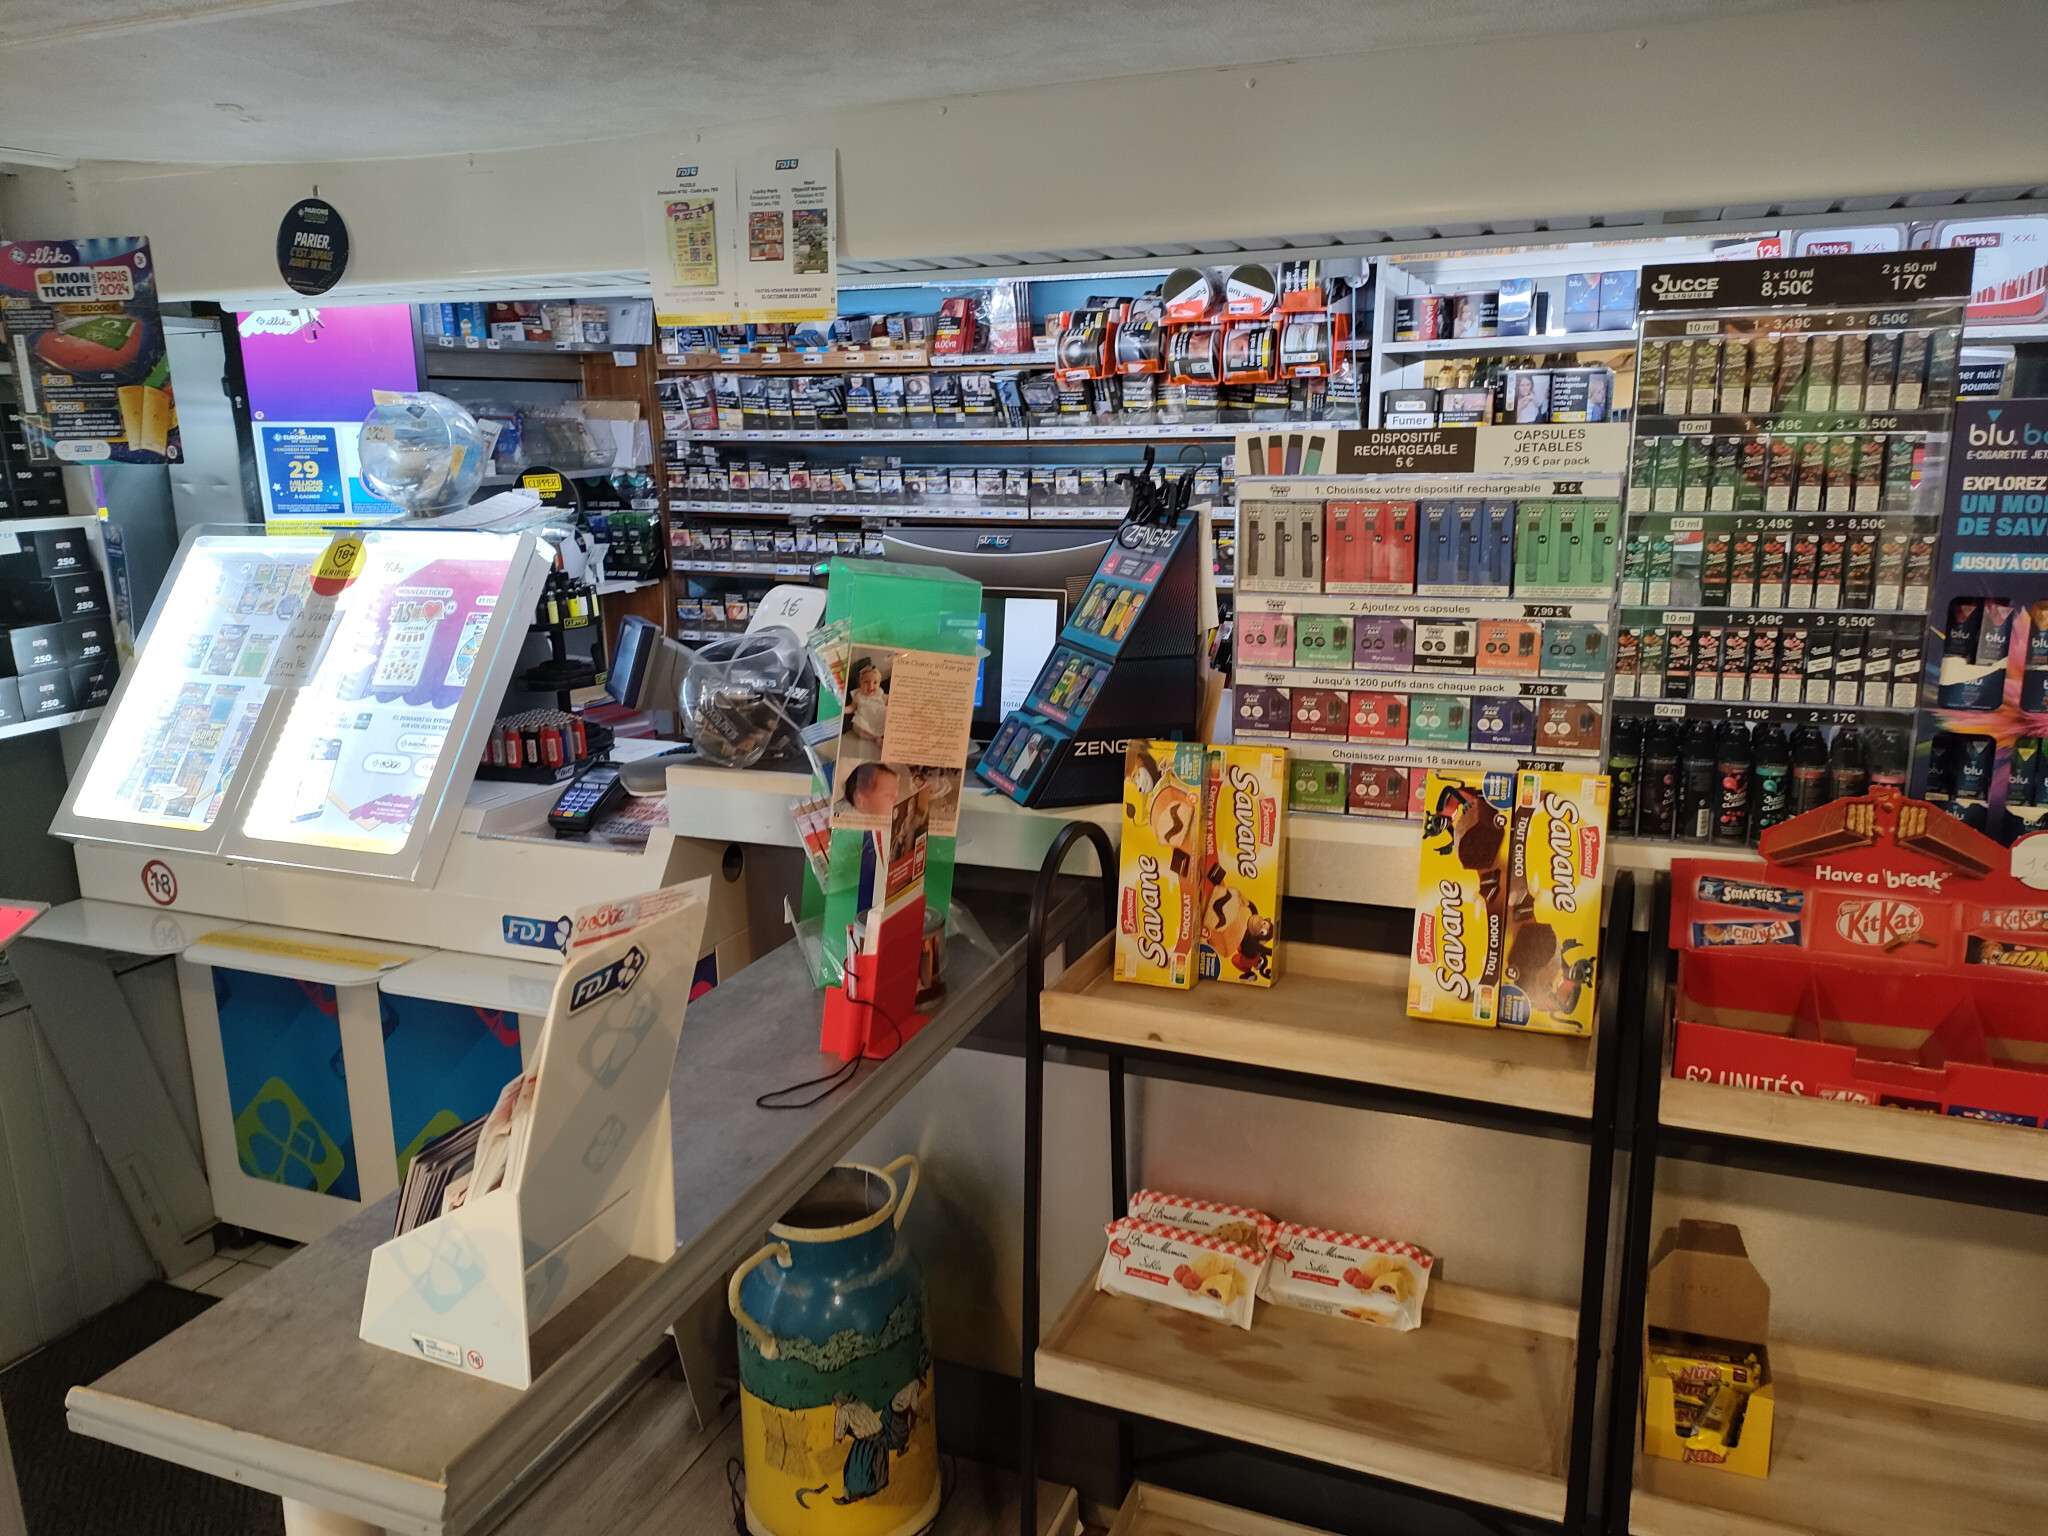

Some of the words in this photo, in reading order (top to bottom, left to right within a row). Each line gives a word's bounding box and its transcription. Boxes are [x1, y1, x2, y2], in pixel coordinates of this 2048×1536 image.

[1953, 236, 1997, 248] News
[1758, 245, 1781, 258] 12€
[1809, 243, 1849, 255] News
[27, 247, 72, 265] illiko
[1762, 271, 1770, 280] 3
[1784, 270, 1797, 279] 10
[1799, 269, 1815, 279] ml
[1881, 264, 1890, 274] 2
[1903, 263, 1918, 273] 50
[1921, 262, 1936, 272] ml
[56, 272, 91, 284] MON
[96, 270, 129, 283] PARIS
[1891, 274, 1927, 290] 17€
[41, 286, 92, 298] TICKET
[99, 284, 130, 297] 2024
[1761, 281, 1813, 299] 8,50€
[1775, 317, 1812, 330] 3,49€
[1846, 316, 1855, 326] 3
[1868, 313, 1909, 326] 8,50€
[1688, 324, 1700, 332] 10
[1703, 322, 1715, 331] ml
[1392, 415, 1428, 426] Fumer
[1680, 423, 1692, 432] 10
[1695, 422, 1708, 431] ml
[1765, 419, 1802, 432] 3,49€
[1836, 420, 1845, 429] 3
[1858, 418, 1897, 430] 8,50€
[1371, 432, 1442, 443] DISPOSITIF
[1514, 429, 1586, 440] CAPSULES
[1354, 444, 1458, 456] RECHARGEABLE
[1514, 441, 1583, 453] JETABLES
[1966, 449, 2027, 460] E-CIGARETTE
[1395, 458, 1403, 468] 5
[1405, 457, 1415, 468] €
[1504, 456, 1530, 467] 7,99
[1532, 455, 1541, 466] €
[1543, 458, 1561, 468] par
[1563, 456, 1591, 467] pack
[16, 471, 33, 479] 100
[288, 461, 319, 479] 29
[1326, 485, 1381, 495] Choisissez
[1384, 486, 1412, 495] votre
[1414, 483, 1465, 496] dispositif
[1467, 483, 1541, 496] rechargeable
[1559, 483, 1568, 493] 5
[1568, 483, 1577, 493] €
[1962, 476, 2047, 491] EXPLOREZ
[1960, 495, 1996, 513] UN
[1673, 520, 1685, 529] 10
[1687, 520, 1700, 529] ml
[1736, 519, 1742, 528] 1
[1756, 518, 1793, 530] 3,49€
[1826, 519, 1835, 529] 3
[1848, 518, 1887, 530] 8,50€
[1957, 518, 1989, 536] DE
[57, 557, 75, 566] 250
[1955, 555, 2020, 572] JUSQU'À
[77, 601, 94, 610] 250
[780, 597, 804, 618] 1€
[1361, 603, 1400, 613] Ajoutez
[1402, 604, 1420, 612] vos
[1423, 604, 1471, 614] capsules
[1532, 606, 1554, 616] 7,99
[1555, 607, 1563, 616] €
[1664, 614, 1677, 623] 10
[1680, 614, 1692, 623] ml
[1727, 615, 1734, 624] 1
[1748, 614, 1784, 627] 3,49€
[1816, 617, 1825, 626] 3
[1838, 616, 1876, 628] 8,50€
[1951, 629, 1970, 640] blu
[1985, 632, 2006, 643] blu
[84, 646, 101, 655] 250
[34, 654, 52, 663] 250
[1312, 676, 1351, 688] Jusqu'à
[1354, 678, 1378, 687] 1200
[1381, 679, 1407, 690] puffs
[1409, 680, 1435, 690] dans
[1437, 682, 1476, 693] chaque
[1479, 683, 1505, 694] pack
[1529, 684, 1550, 695] 7,99
[1550, 685, 1558, 695] €
[41, 699, 59, 708] 250
[1656, 706, 1670, 715] 50
[1673, 705, 1685, 715] ml
[1726, 709, 1732, 718] 1
[1746, 709, 1770, 720] 10€
[1810, 712, 1818, 721] 2
[1832, 713, 1856, 724] 17€
[1332, 749, 1386, 760] Choisissez
[1388, 753, 1423, 764] parmis
[1426, 755, 1438, 764] 18
[1441, 758, 1482, 768] saveurs
[1964, 765, 1983, 776] blu
[2009, 773, 2029, 784] blu
[1229, 764, 1260, 880] Savane
[1518, 816, 1529, 841] TOUT
[1546, 792, 1579, 913] Savane
[1514, 842, 1525, 877] CHOCO
[1815, 865, 1863, 885] Have
[1867, 872, 1879, 885] a
[1722, 886, 1783, 903] SMARTIES
[1138, 854, 1169, 968] Savane
[1180, 894, 1193, 941] CHOCOLAT
[1848, 902, 1920, 945] KitKat
[506, 919, 546, 943] FDJ
[1489, 914, 1499, 949] CHOCO
[1733, 920, 1789, 942] CRUNCH
[1436, 879, 1472, 1000] Savane
[1485, 949, 1498, 977] TOUT
[573, 969, 613, 1006] FDJ
[1719, 1070, 1805, 1096] UNITÉS
